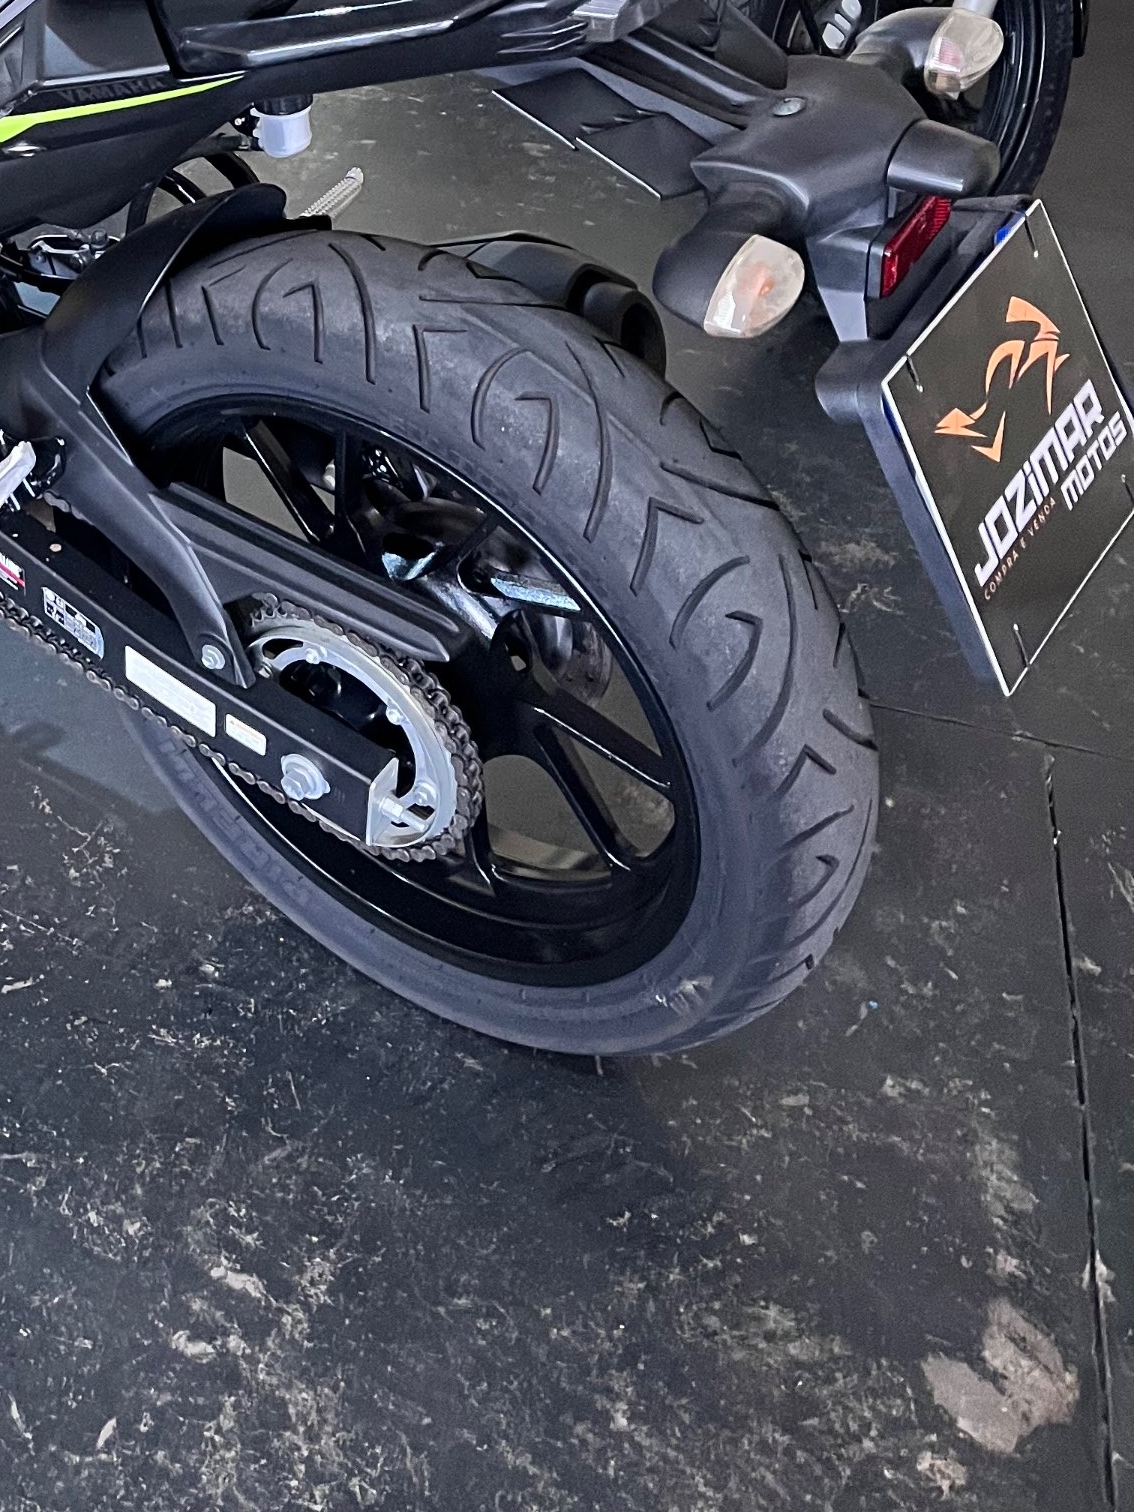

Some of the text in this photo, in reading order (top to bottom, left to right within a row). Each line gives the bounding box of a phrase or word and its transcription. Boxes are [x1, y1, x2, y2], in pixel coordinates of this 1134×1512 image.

[57, 76, 167, 103] YAMAHA
[1060, 410, 1128, 511] MOTOS
[984, 550, 1019, 600] COMPRA
[1027, 496, 1057, 537] VENDA
